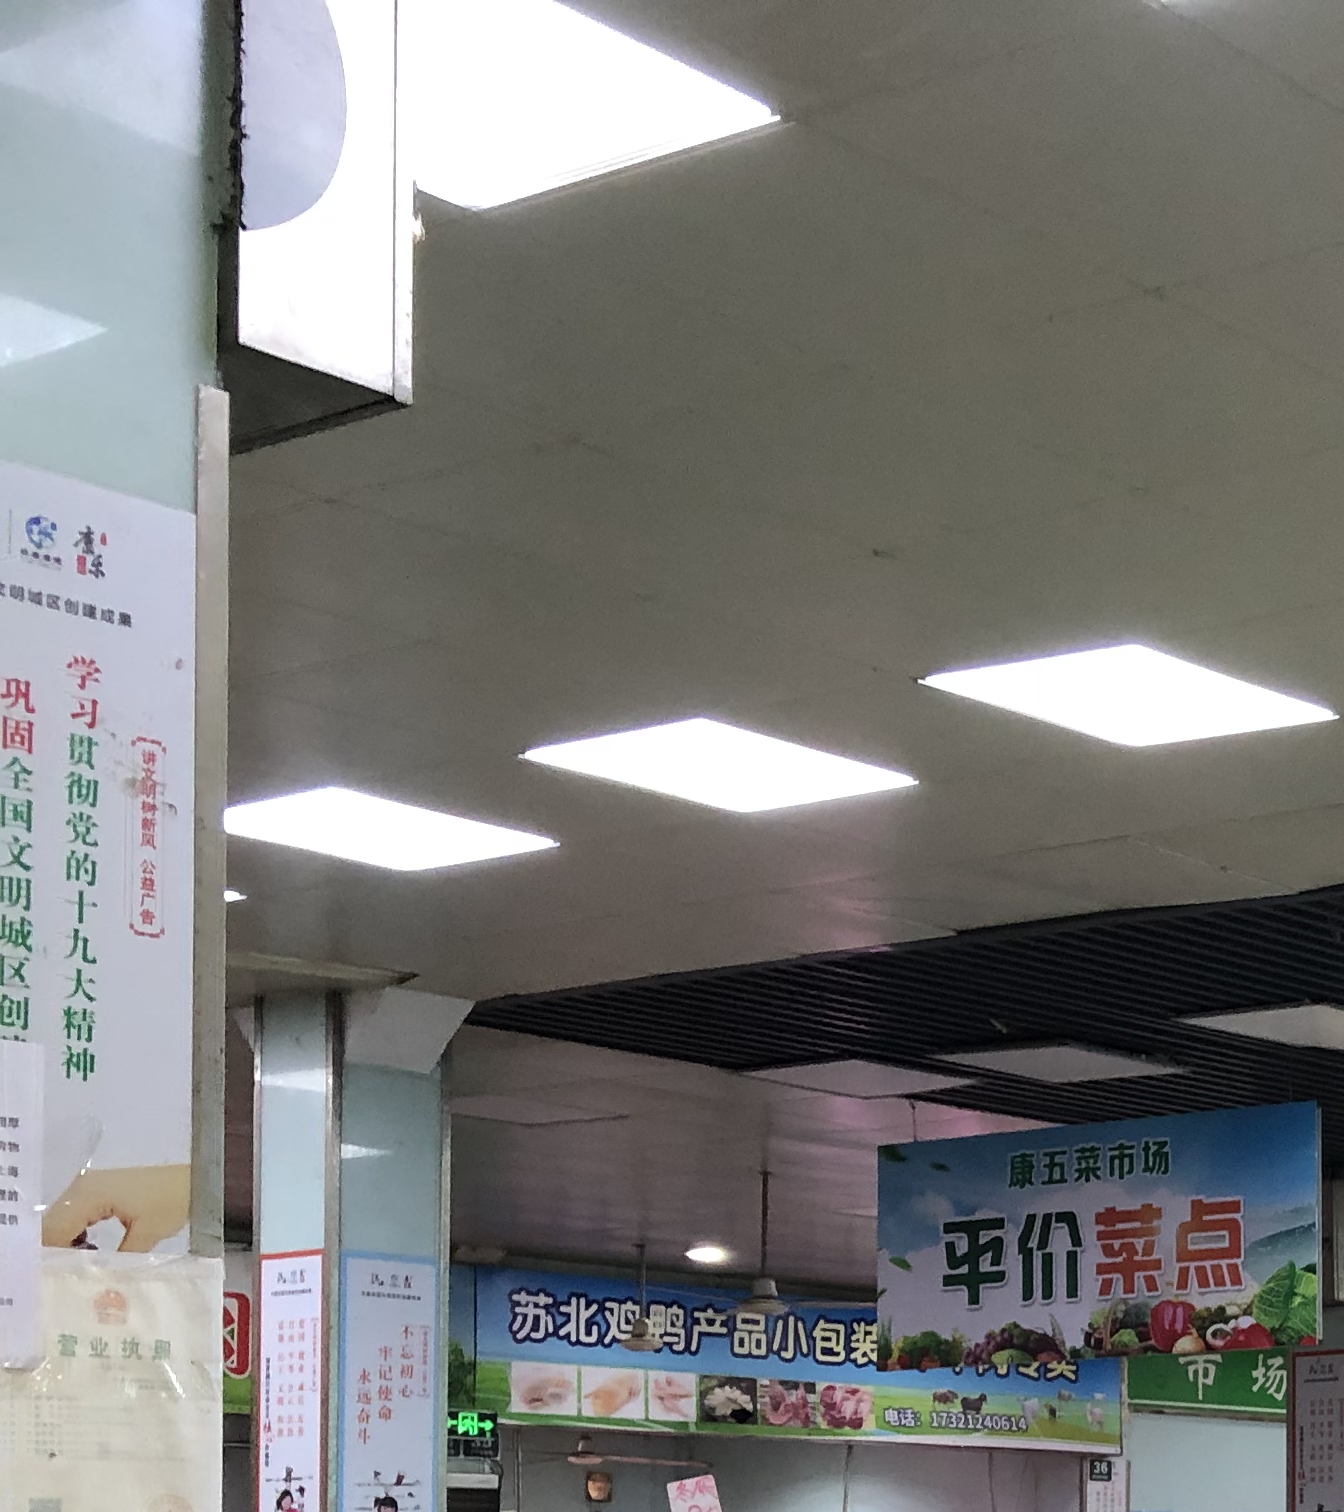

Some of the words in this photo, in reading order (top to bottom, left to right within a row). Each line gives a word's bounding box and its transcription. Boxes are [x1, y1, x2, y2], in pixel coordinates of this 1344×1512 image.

[0, 676, 36, 1043] 巩固全国文明城区创
[65, 654, 102, 1083] 学习贯彻党的十九大精神
[139, 858, 158, 927] 公益广告
[1007, 1138, 1171, 1189] 康五菜市场
[941, 1198, 1244, 1306] 平价菜点
[57, 1333, 172, 1362] 营业执照
